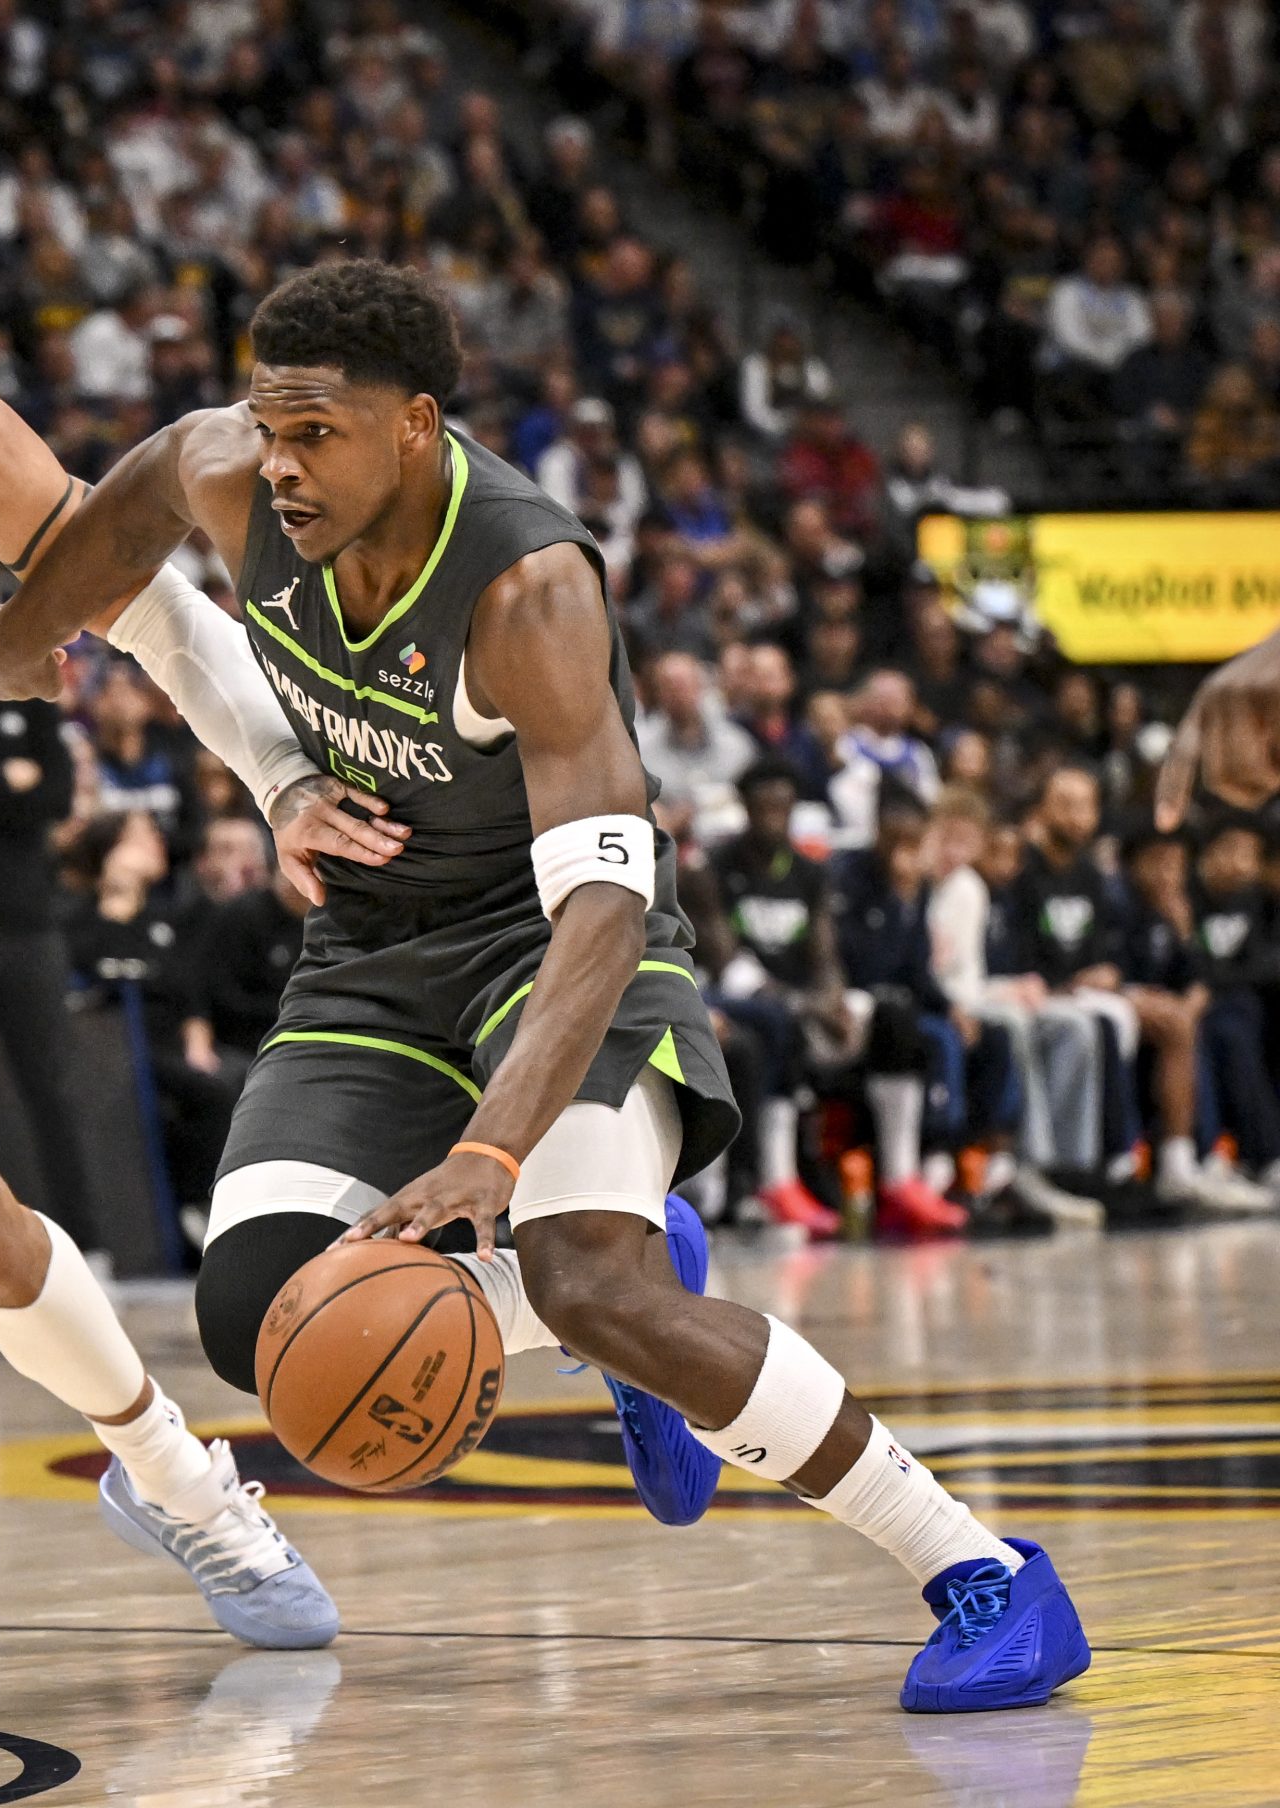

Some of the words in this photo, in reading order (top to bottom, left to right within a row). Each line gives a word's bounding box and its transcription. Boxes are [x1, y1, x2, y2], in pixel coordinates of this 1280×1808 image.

[378, 669, 434, 702] sezzle
[597, 832, 629, 865] 5
[730, 1443, 767, 1463] 5
